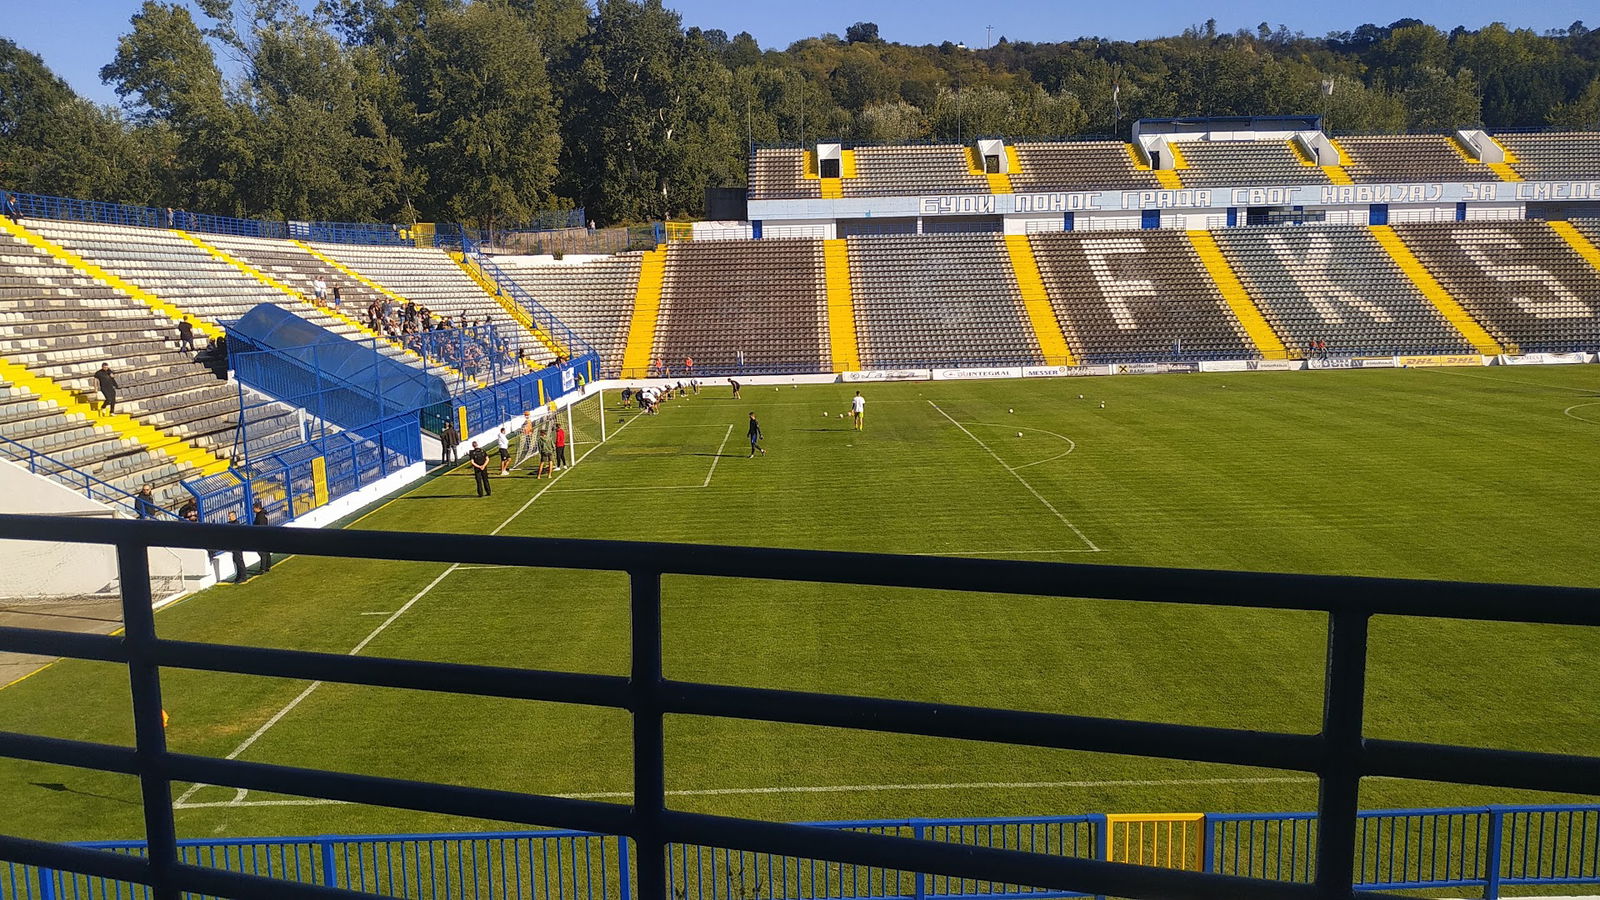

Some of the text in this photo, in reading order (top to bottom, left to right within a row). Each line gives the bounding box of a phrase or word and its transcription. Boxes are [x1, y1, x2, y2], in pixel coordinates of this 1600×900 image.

[919, 195, 995, 214] БУДИ
[1014, 192, 1103, 212] ПОНОС
[1121, 190, 1212, 209] ГРАДА
[1231, 187, 1301, 206] СВОГ
[1321, 184, 1443, 203] НАВИЈАЈ
[1463, 183, 1498, 201] ЗА
